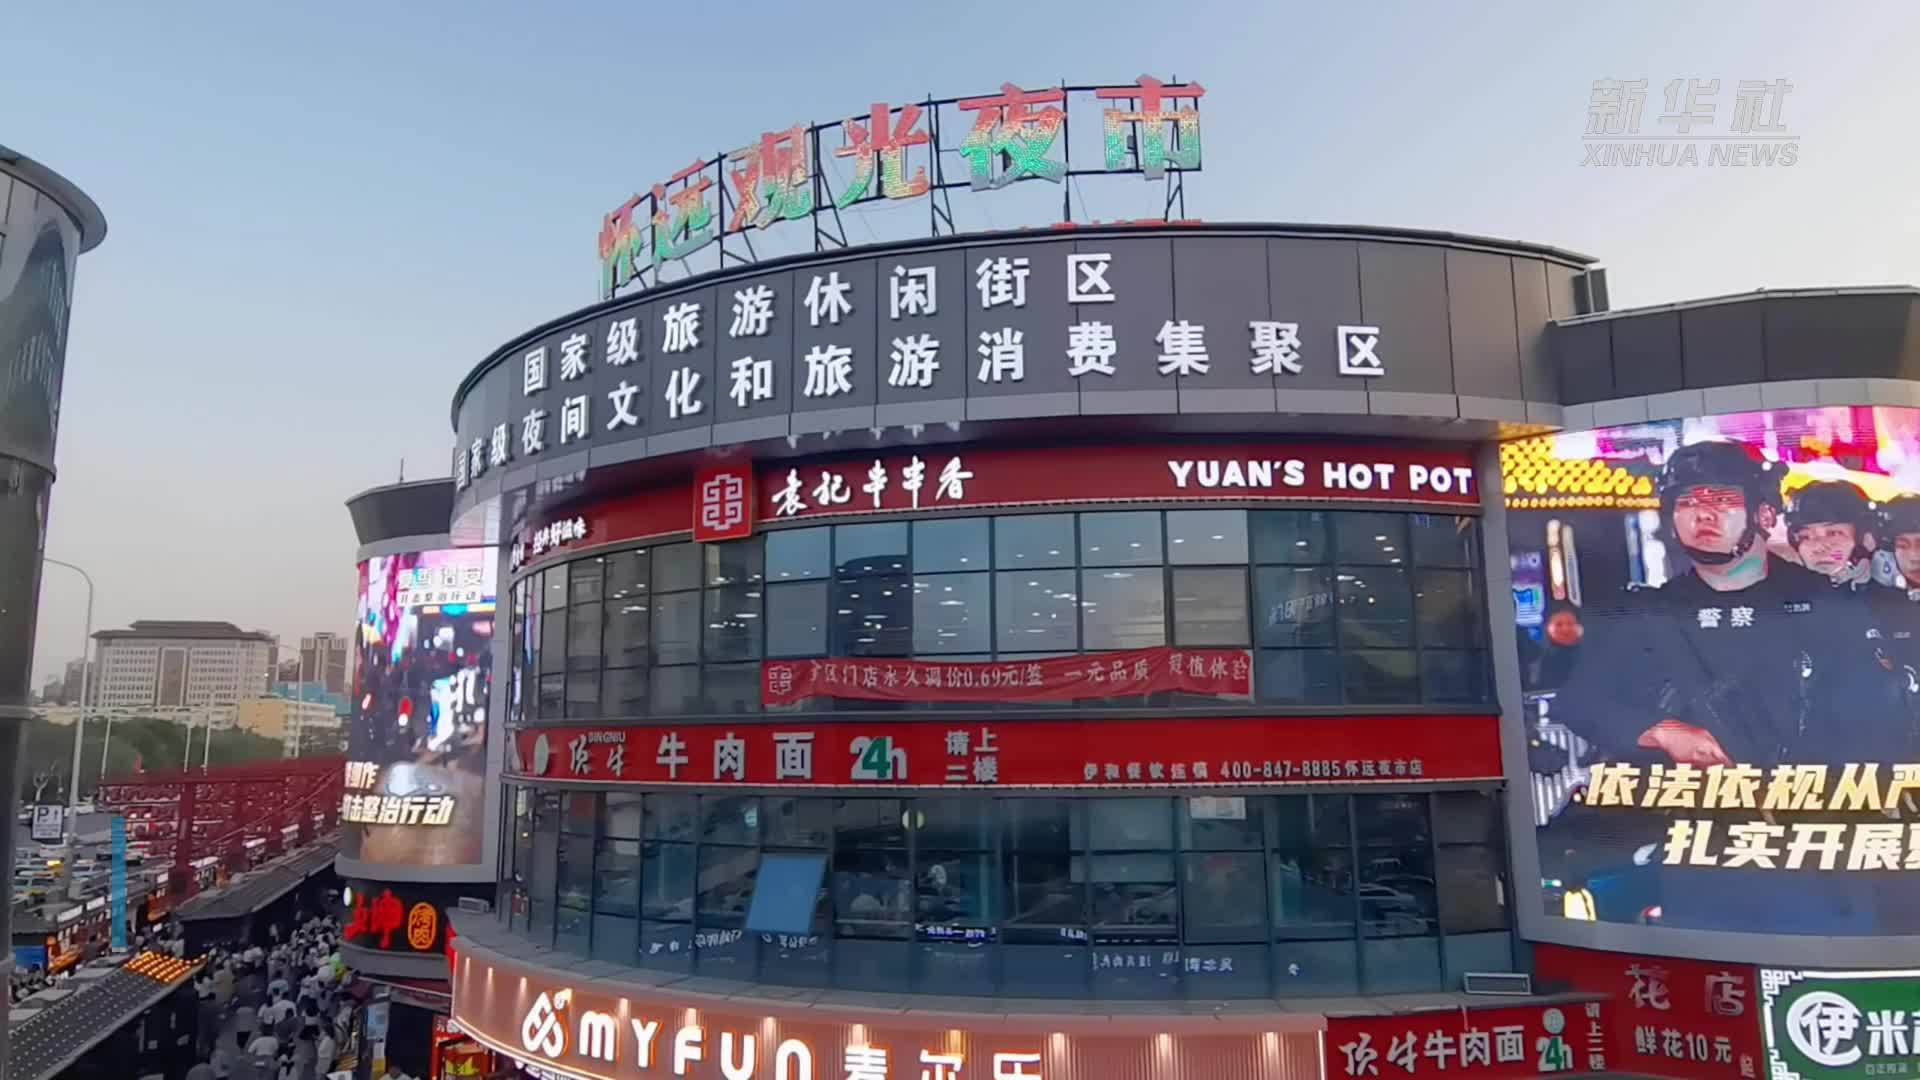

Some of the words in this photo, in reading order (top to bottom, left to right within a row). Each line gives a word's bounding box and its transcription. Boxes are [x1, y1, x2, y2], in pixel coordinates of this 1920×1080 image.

[599, 75, 1205, 299] 怀远观光夜市
[523, 253, 1115, 396] 国家级旅游休闲街区
[456, 319, 1384, 492] 国家级夜间文化和旅游消费集聚区
[771, 455, 973, 516] 袁记串串香
[1167, 459, 1305, 488] YUAN'S
[1323, 461, 1394, 490] HOT
[1409, 465, 1472, 494] POT
[1697, 606, 1755, 628] 警察
[1064, 659, 1151, 681] 一元品质
[656, 732, 815, 780] 牛肉面
[850, 736, 908, 780] 24h
[945, 727, 999, 756] 请上
[945, 756, 998, 782] 二楼
[1220, 759, 1341, 779] 400-847-8885
[1345, 759, 1424, 777] 怀远夜市店
[1586, 761, 1920, 811] 依法依规从严
[1662, 819, 1920, 872] 扎实开展
[1624, 963, 1746, 1016] 花店
[1536, 1035, 1574, 1072] 24h
[1634, 1024, 1733, 1064] 鲜花10元
